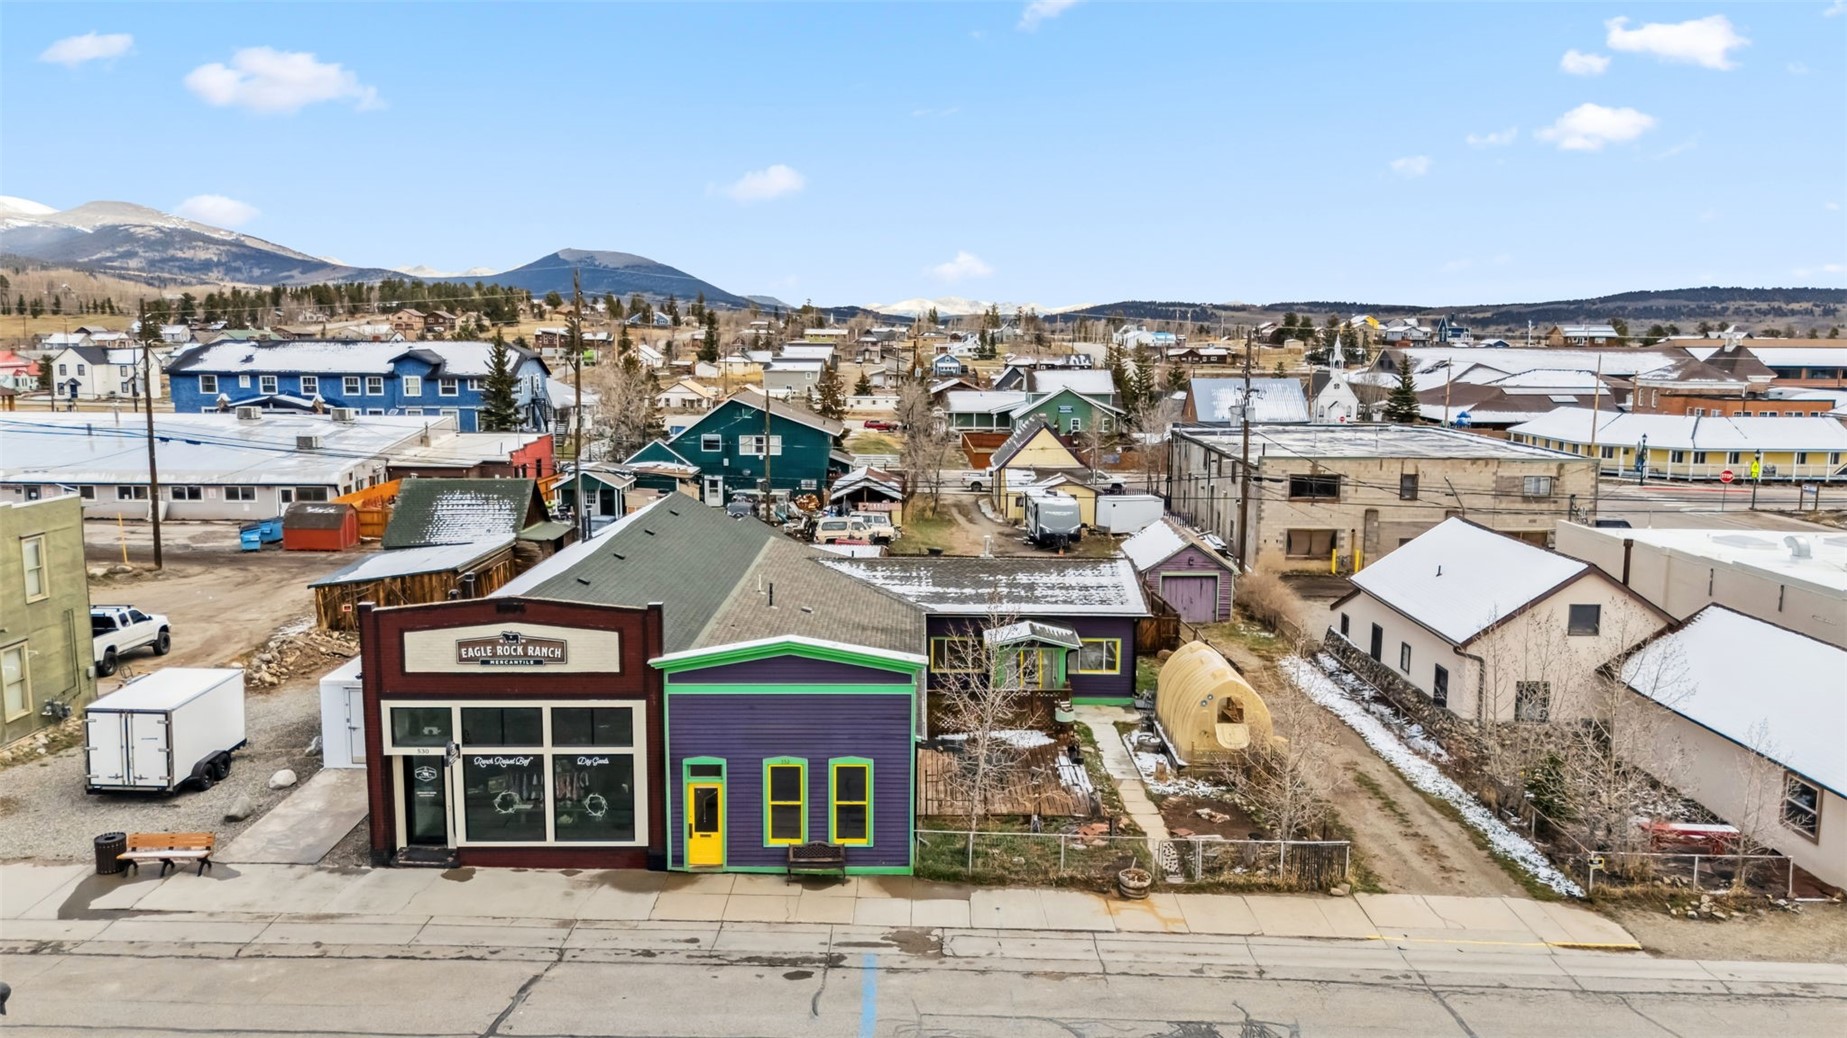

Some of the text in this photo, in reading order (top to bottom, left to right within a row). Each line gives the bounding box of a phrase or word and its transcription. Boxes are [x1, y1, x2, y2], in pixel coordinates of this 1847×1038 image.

[461, 645, 562, 658] EAGLE ROCK RANCH
